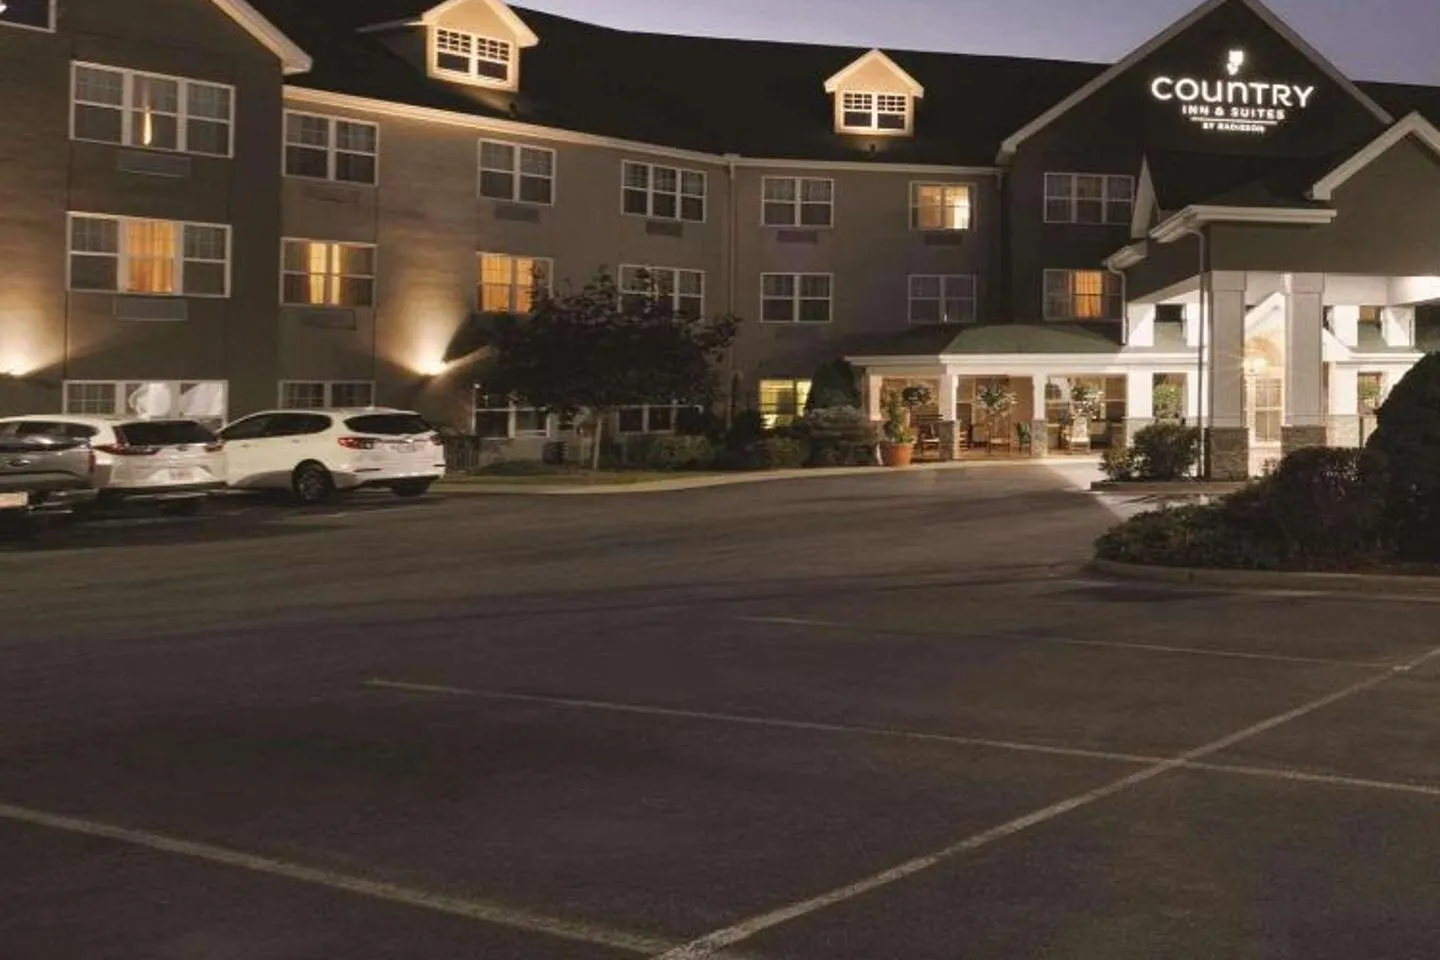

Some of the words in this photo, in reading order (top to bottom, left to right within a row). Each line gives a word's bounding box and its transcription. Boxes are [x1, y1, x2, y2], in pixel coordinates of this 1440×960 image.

[1182, 105, 1210, 117] INN
[1214, 107, 1225, 117] &
[1230, 107, 1285, 120] SUITES
[1202, 122, 1215, 130] BY
